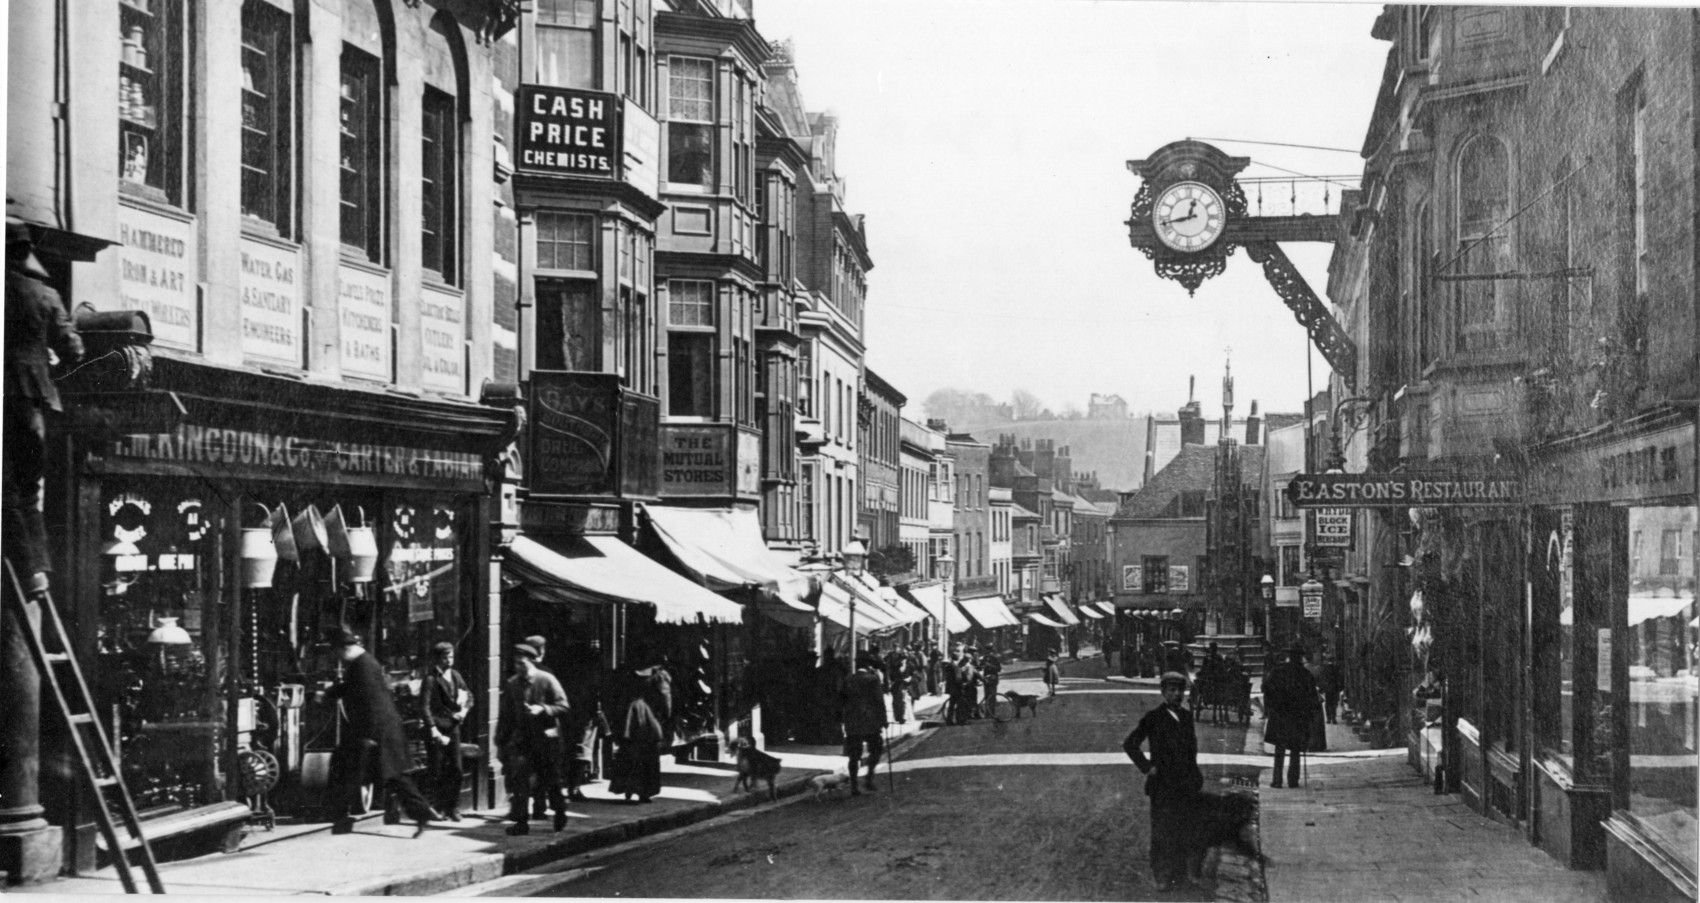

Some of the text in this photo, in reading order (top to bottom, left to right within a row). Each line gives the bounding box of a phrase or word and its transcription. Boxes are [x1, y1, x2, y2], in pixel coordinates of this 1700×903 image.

[533, 93, 603, 120] CASH
[530, 121, 606, 148] PRICE
[120, 222, 185, 260] HAMMERED
[160, 267, 184, 293] ART
[275, 260, 294, 285] GAS
[673, 437, 713, 450] THE
[662, 452, 724, 466] MUTUAL
[663, 469, 724, 483] STORES
[1297, 480, 1406, 500] EASTON'S
[1318, 516, 1348, 525] BLOCK
[1318, 525, 1348, 534] ICE
